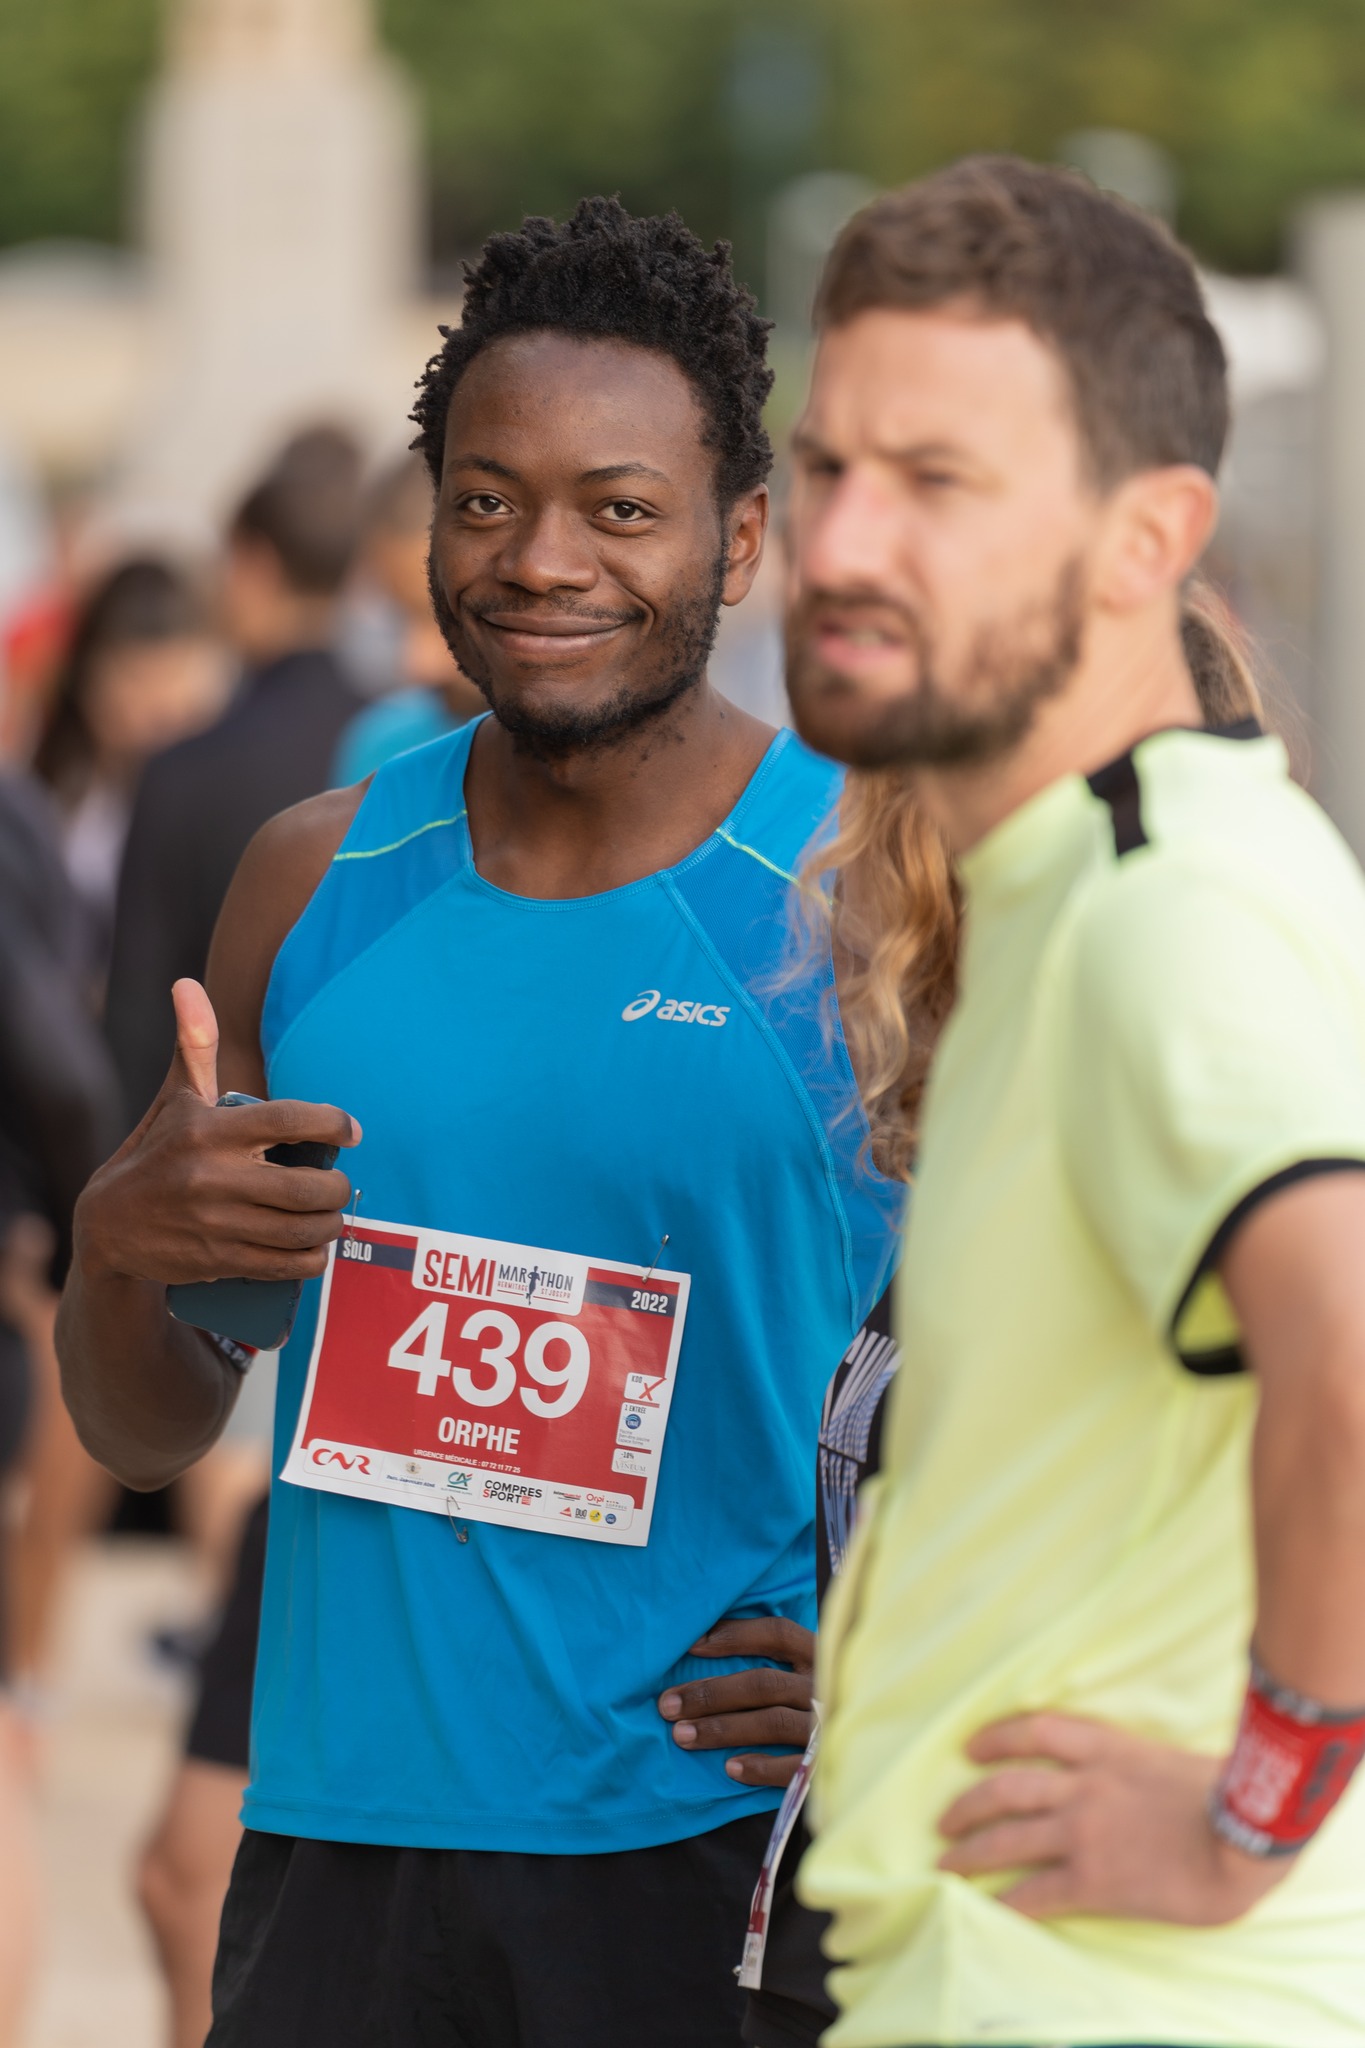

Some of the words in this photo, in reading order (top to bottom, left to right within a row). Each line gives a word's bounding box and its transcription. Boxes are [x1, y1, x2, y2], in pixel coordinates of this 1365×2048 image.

[656, 999, 731, 1027] asics
[342, 1239, 373, 1262] SOLO
[422, 1249, 497, 1297] SEMI
[498, 1263, 574, 1292] MARTHON
[497, 1280, 528, 1292] HERMITAGE
[631, 1290, 669, 1314] 2022
[387, 1301, 591, 1419] 439
[629, 1405, 647, 1414] ENTRÉE
[438, 1416, 521, 1455] ORPHE
[312, 1448, 371, 1475] CNR
[413, 1448, 444, 1460] URGENCE
[445, 1453, 478, 1466] MÉDICALE
[490, 1462, 497, 1470] 72
[497, 1463, 504, 1471] 11
[512, 1466, 521, 1474] 25
[482, 1488, 522, 1504] SPORT
[484, 1479, 543, 1498] COMPRES
[586, 1493, 605, 1504] Orpi
